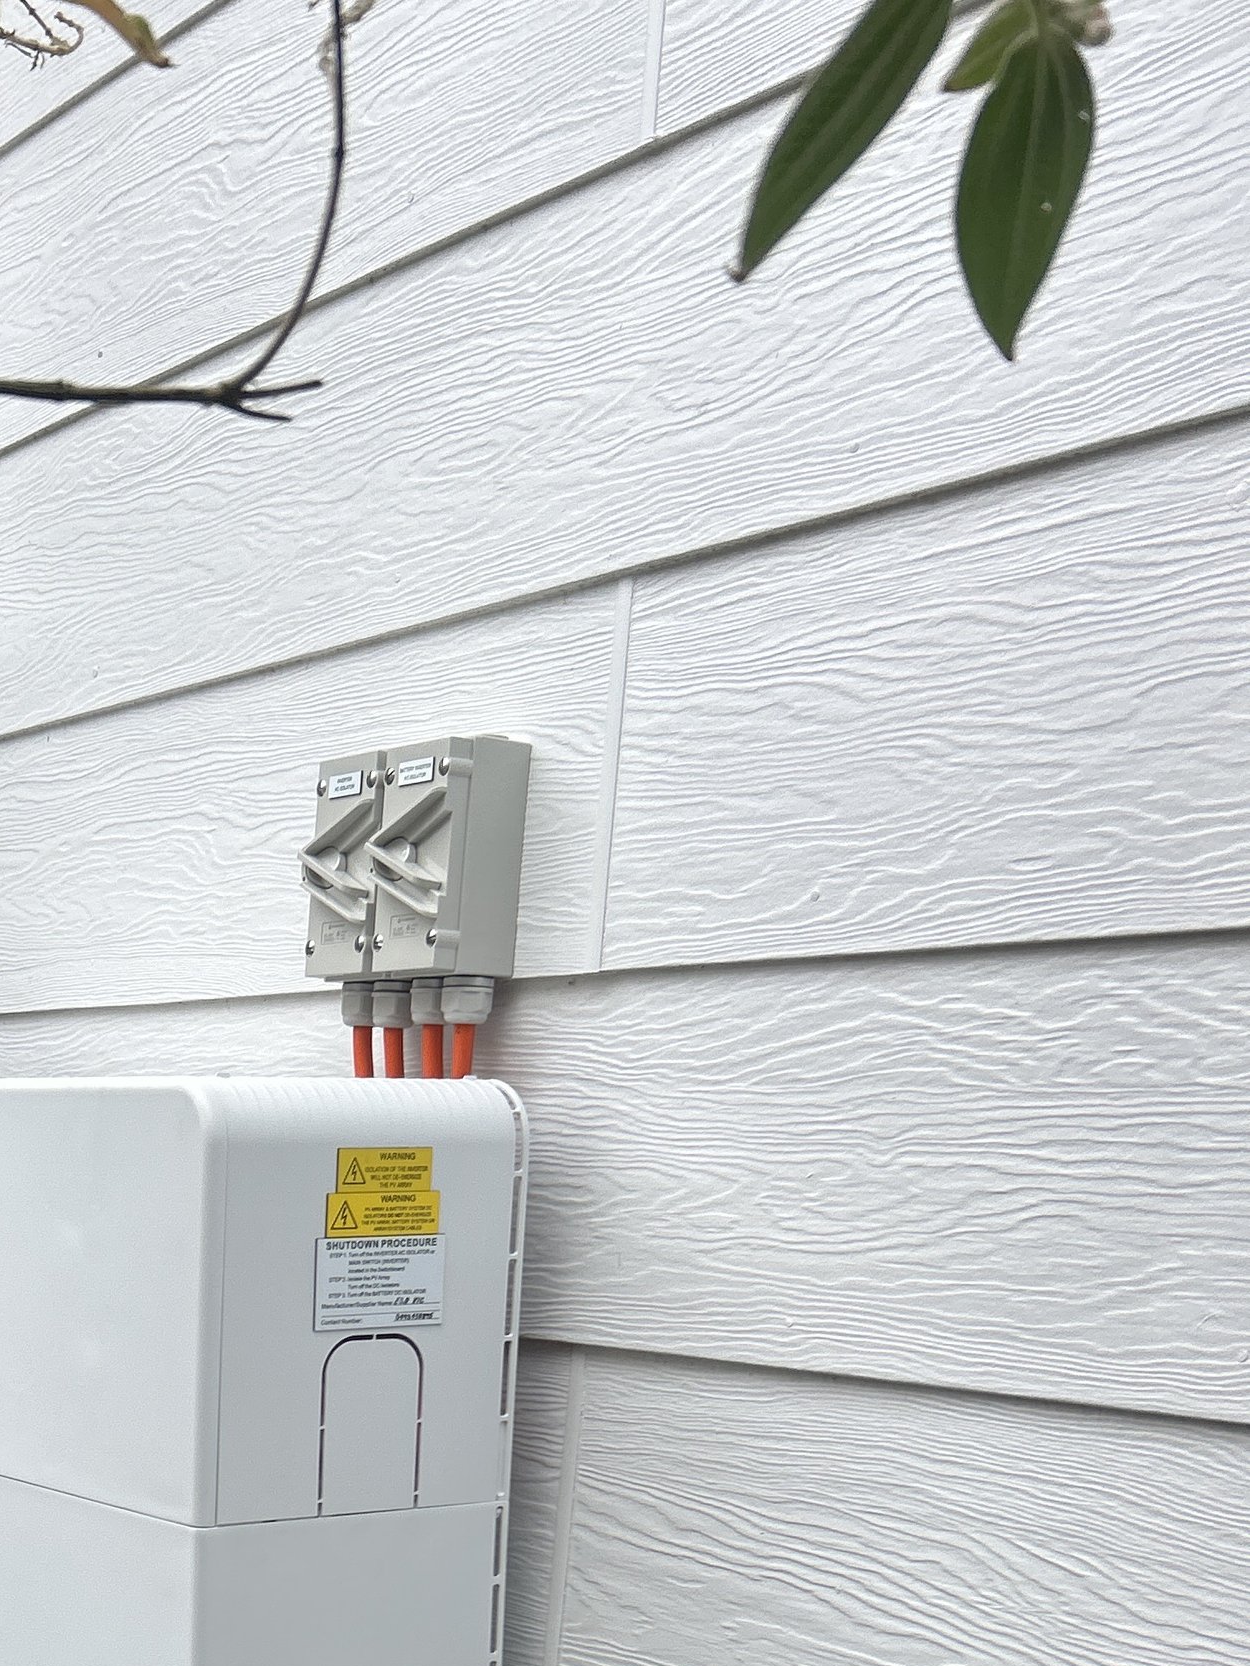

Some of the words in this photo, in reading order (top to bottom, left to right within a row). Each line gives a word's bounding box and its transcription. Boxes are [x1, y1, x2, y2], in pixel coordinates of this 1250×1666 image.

[380, 1152, 416, 1160] WARNING
[381, 1194, 416, 1203] WARNING
[326, 1240, 379, 1250] SHUTDOWN
[380, 1238, 437, 1248] PROCEDURE
